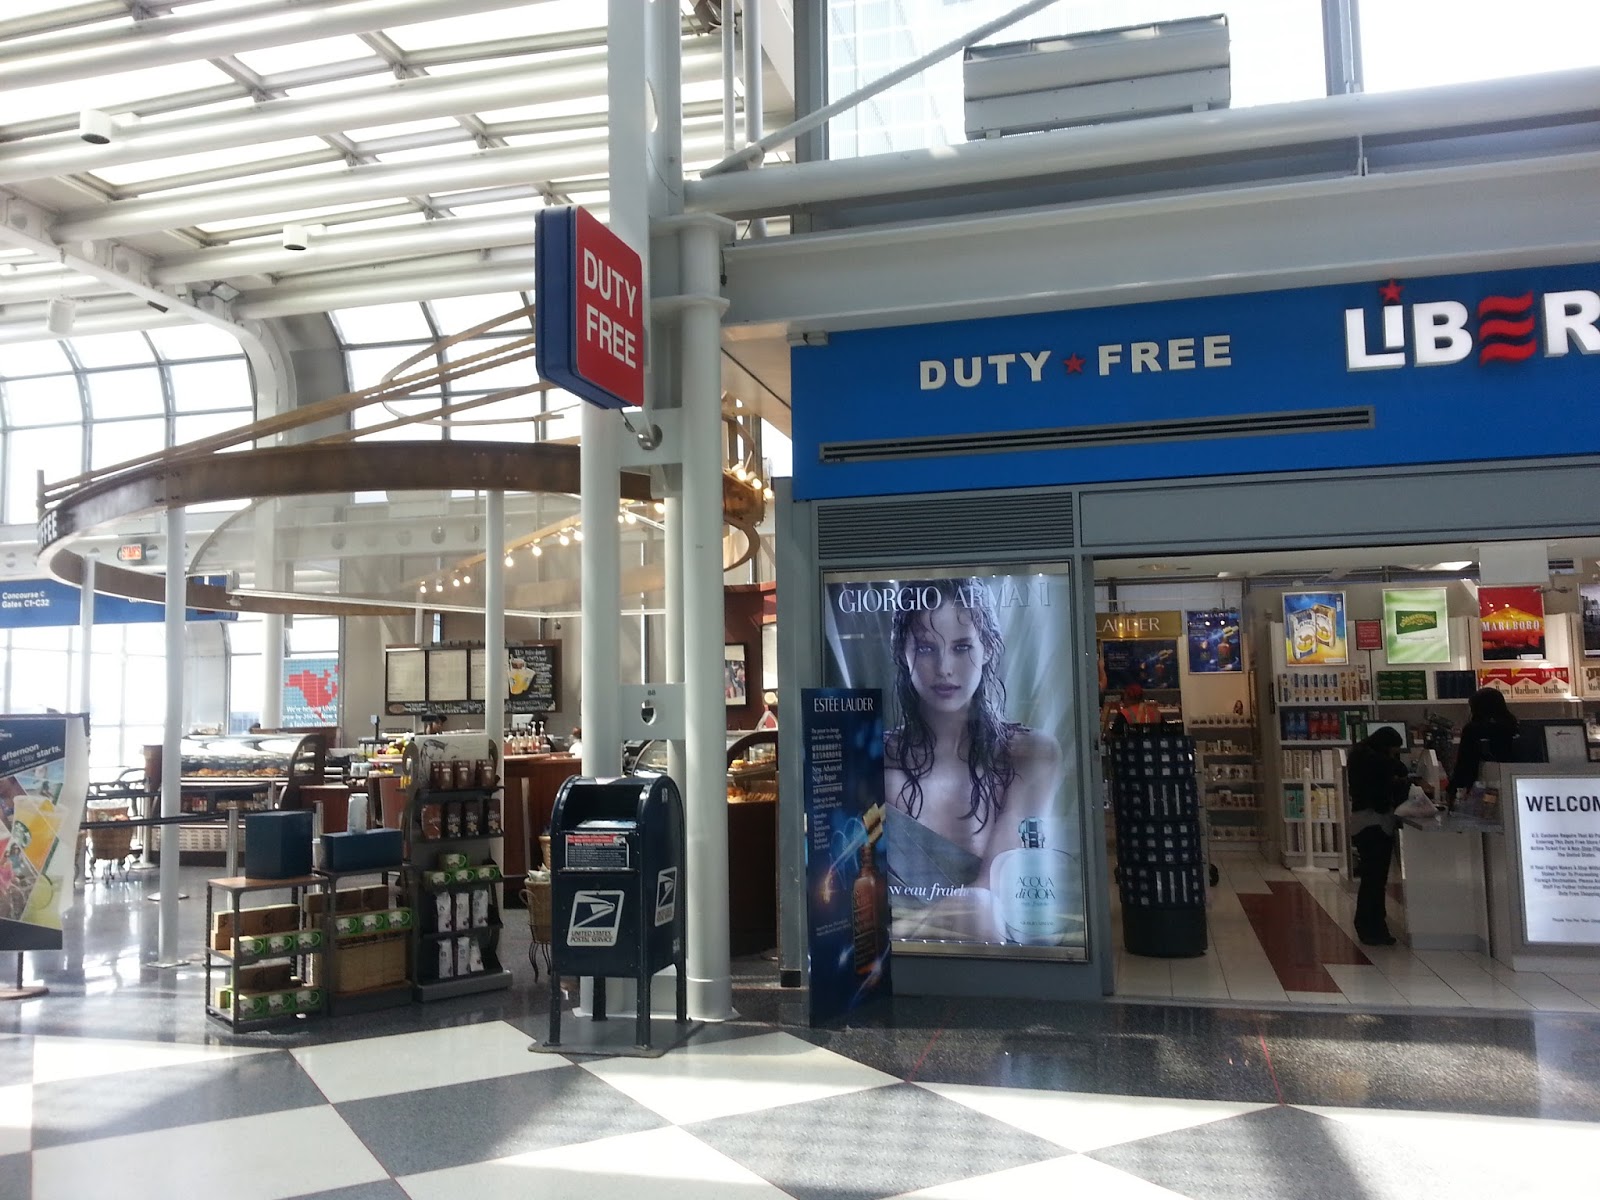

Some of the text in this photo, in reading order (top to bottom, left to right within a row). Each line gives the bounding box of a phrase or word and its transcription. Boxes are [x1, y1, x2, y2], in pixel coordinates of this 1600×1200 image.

[584, 248, 637, 318] DUTY
[586, 303, 637, 369] FREE
[920, 335, 1232, 390] DUTY FREE
[2, 592, 39, 600] Concourse
[838, 580, 1051, 614] GIORGIO ARMANI
[2, 600, 21, 608] Gates
[1482, 620, 1540, 632] MARLBORO
[1514, 684, 1540, 695] Marlboro
[1542, 684, 1569, 694] Marlboro
[841, 697, 874, 712] LAUDER
[1, 743, 39, 761] afternoon
[36, 745, 61, 758] starts.
[1015, 876, 1055, 888] ACQUA
[903, 886, 927, 897] eau
[1015, 888, 1027, 899] di
